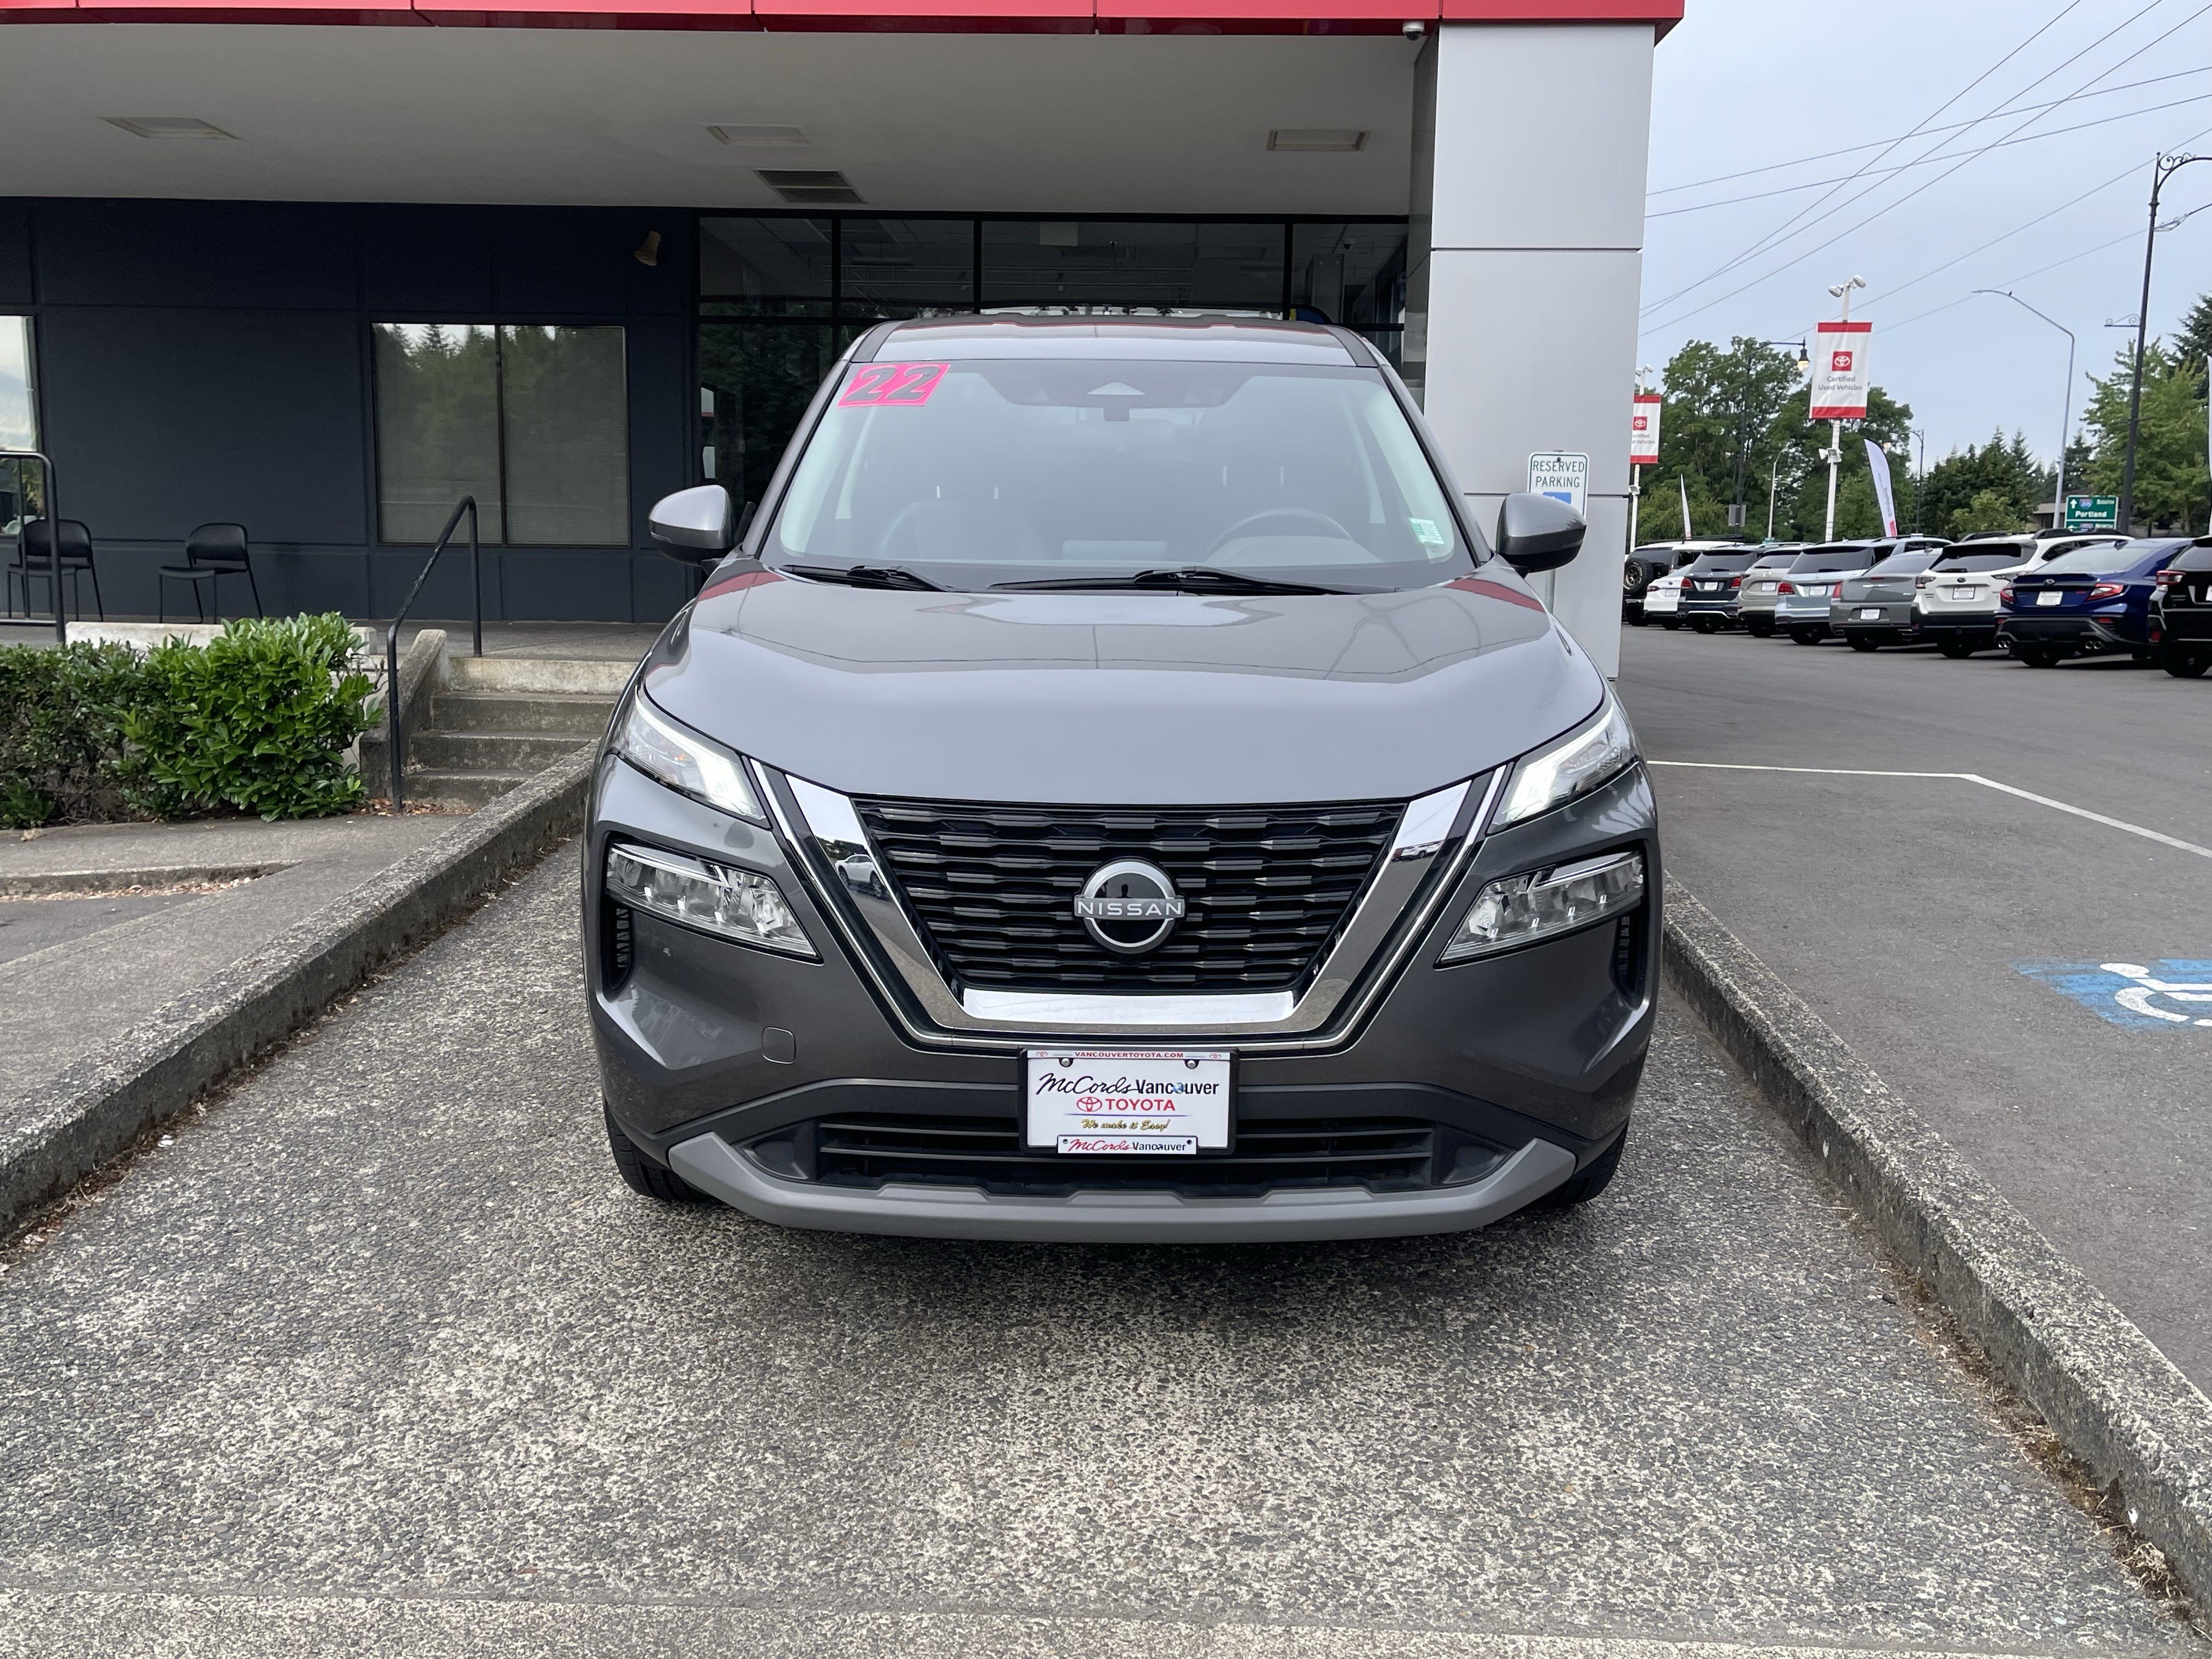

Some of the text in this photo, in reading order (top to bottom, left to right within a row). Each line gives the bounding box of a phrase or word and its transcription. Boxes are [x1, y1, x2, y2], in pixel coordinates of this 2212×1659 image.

[845, 366, 941, 402] 22
[1533, 461, 1584, 472] RESERVED
[1536, 476, 1580, 487] PARKING
[1078, 901, 1181, 916] NISSAN
[1035, 1073, 1219, 1095] McCords Vancouver
[1105, 1099, 1176, 1111] TOYOTA
[1082, 1119, 1098, 1128] We
[1101, 1120, 1127, 1129] make
[1140, 1119, 1171, 1132] Easy!
[1068, 1139, 1186, 1152] McCords Vancouver
